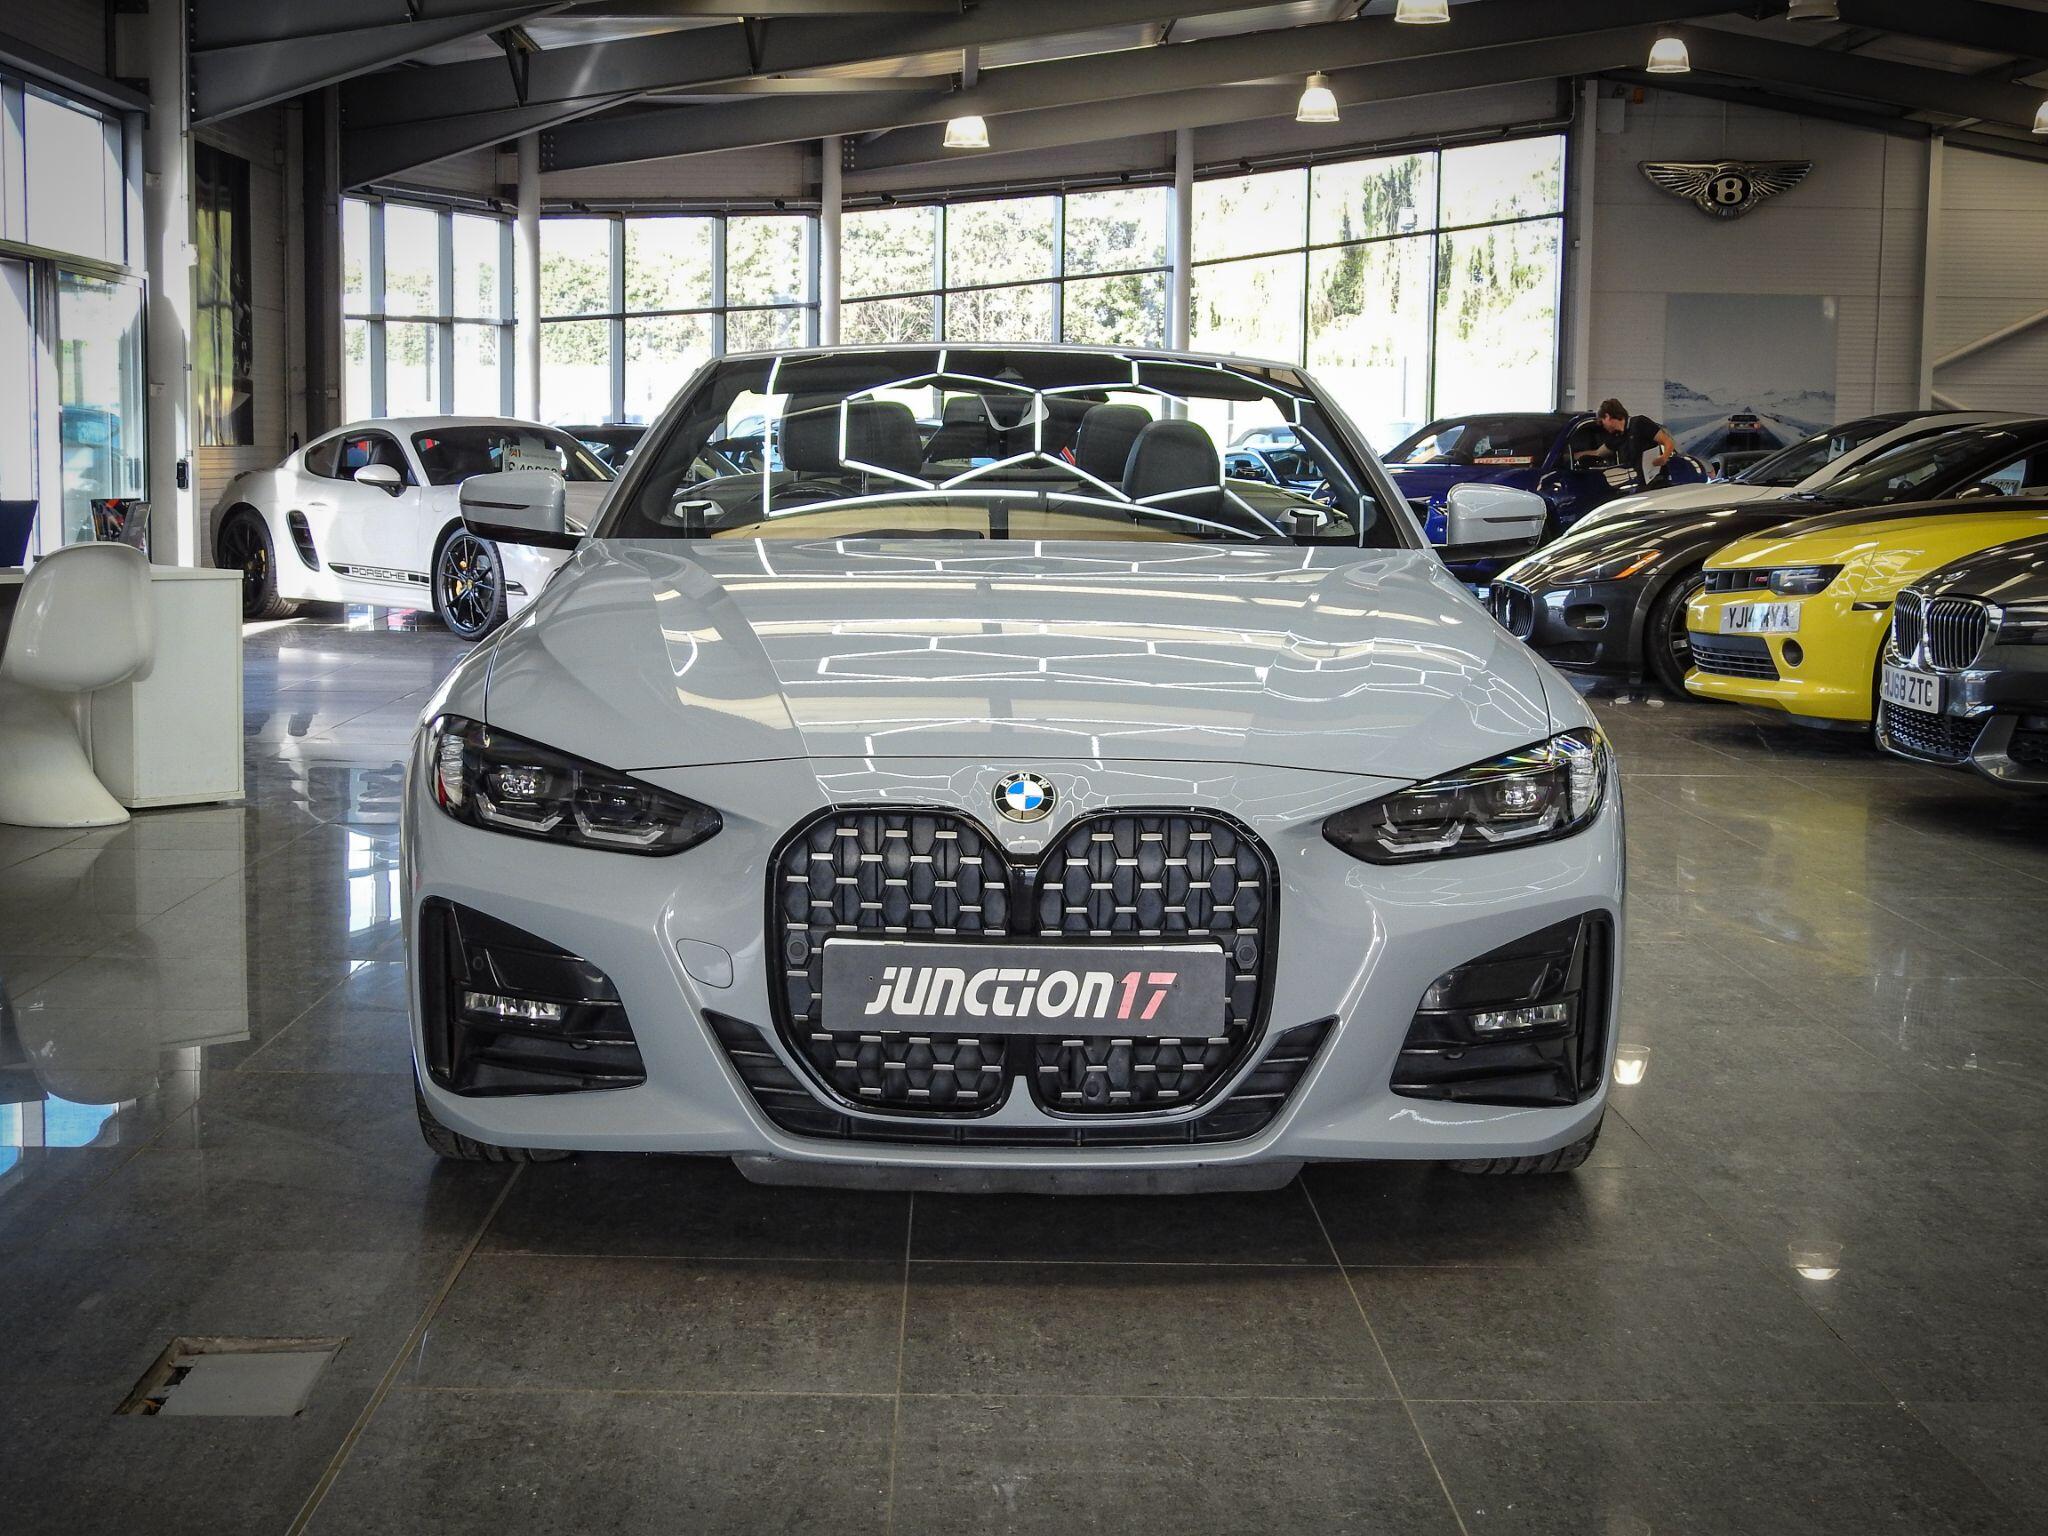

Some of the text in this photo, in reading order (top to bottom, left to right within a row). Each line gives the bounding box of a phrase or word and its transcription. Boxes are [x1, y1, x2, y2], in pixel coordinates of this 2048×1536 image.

[1716, 178, 1743, 204] B
[351, 567, 406, 581] PORSCHE
[1908, 676, 1933, 707] ZTC
[1001, 773, 1051, 789] BMW
